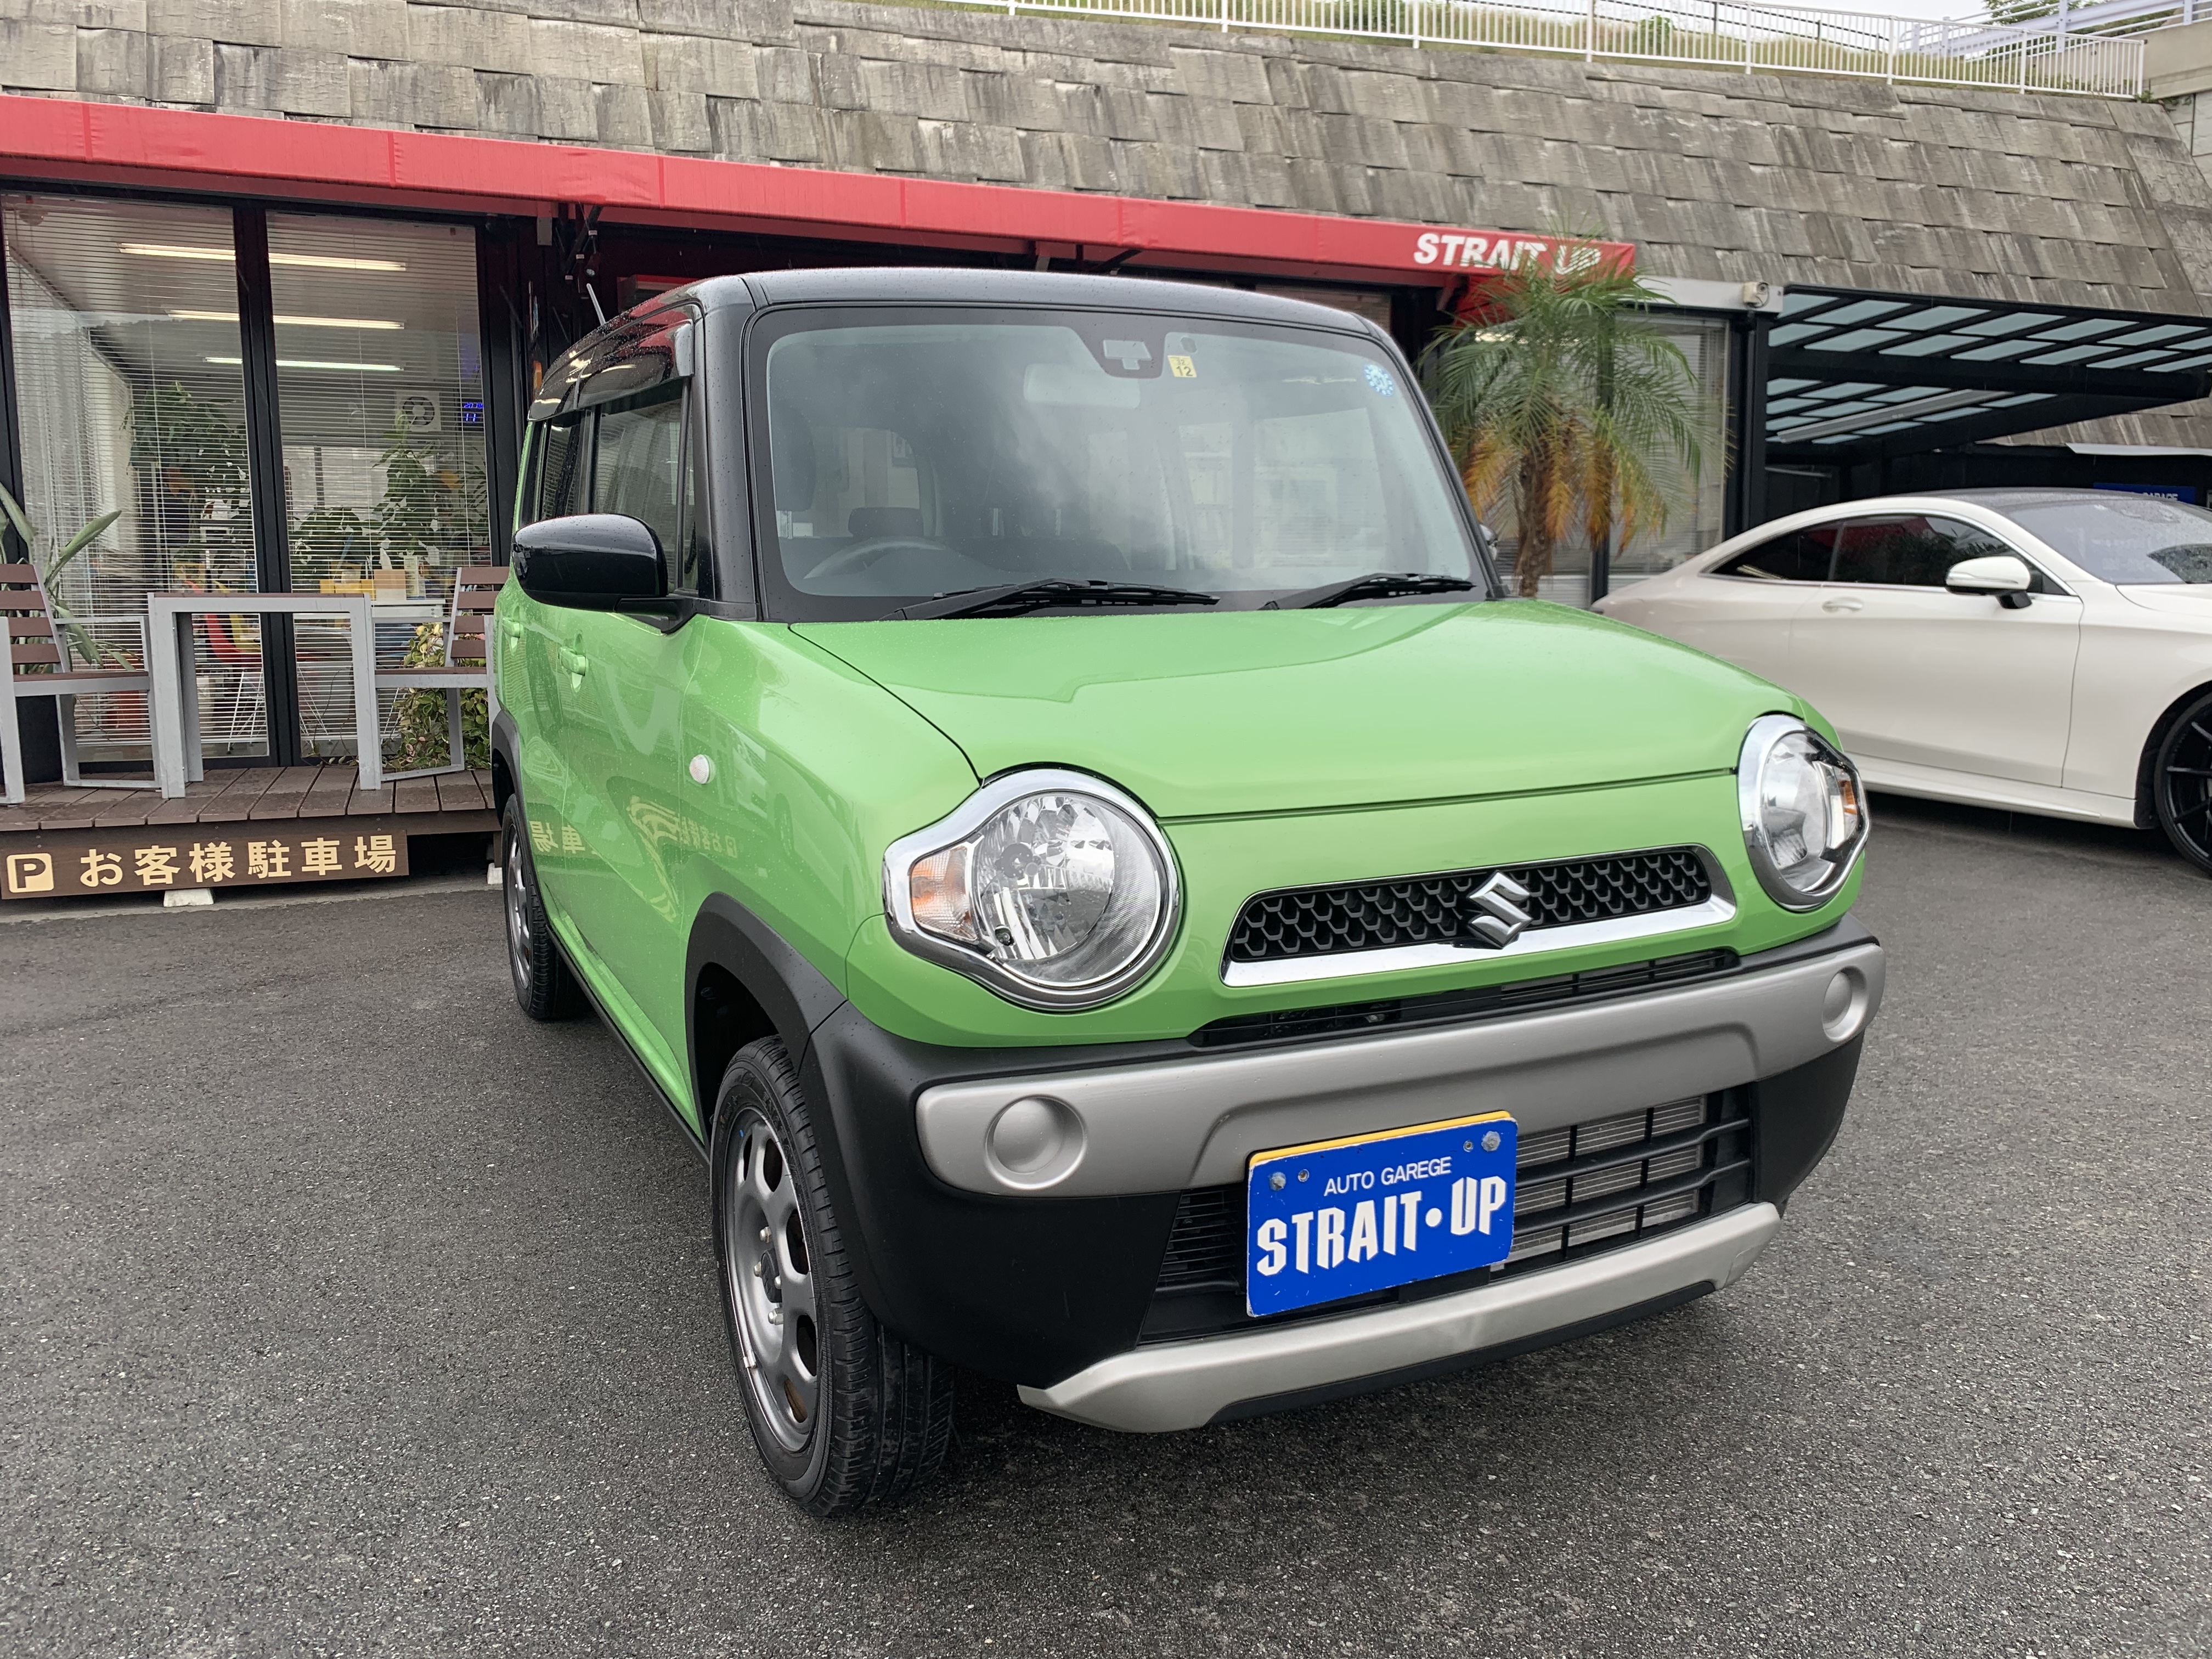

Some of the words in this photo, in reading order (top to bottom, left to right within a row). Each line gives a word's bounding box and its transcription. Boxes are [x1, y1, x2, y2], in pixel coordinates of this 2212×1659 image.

[1413, 233, 1548, 270] STRAIT
[1176, 366, 1193, 376] 12
[80, 834, 397, 888] お客様駐車場
[1323, 1171, 1375, 1197] AUTO
[1380, 1156, 1452, 1186] GAREGE
